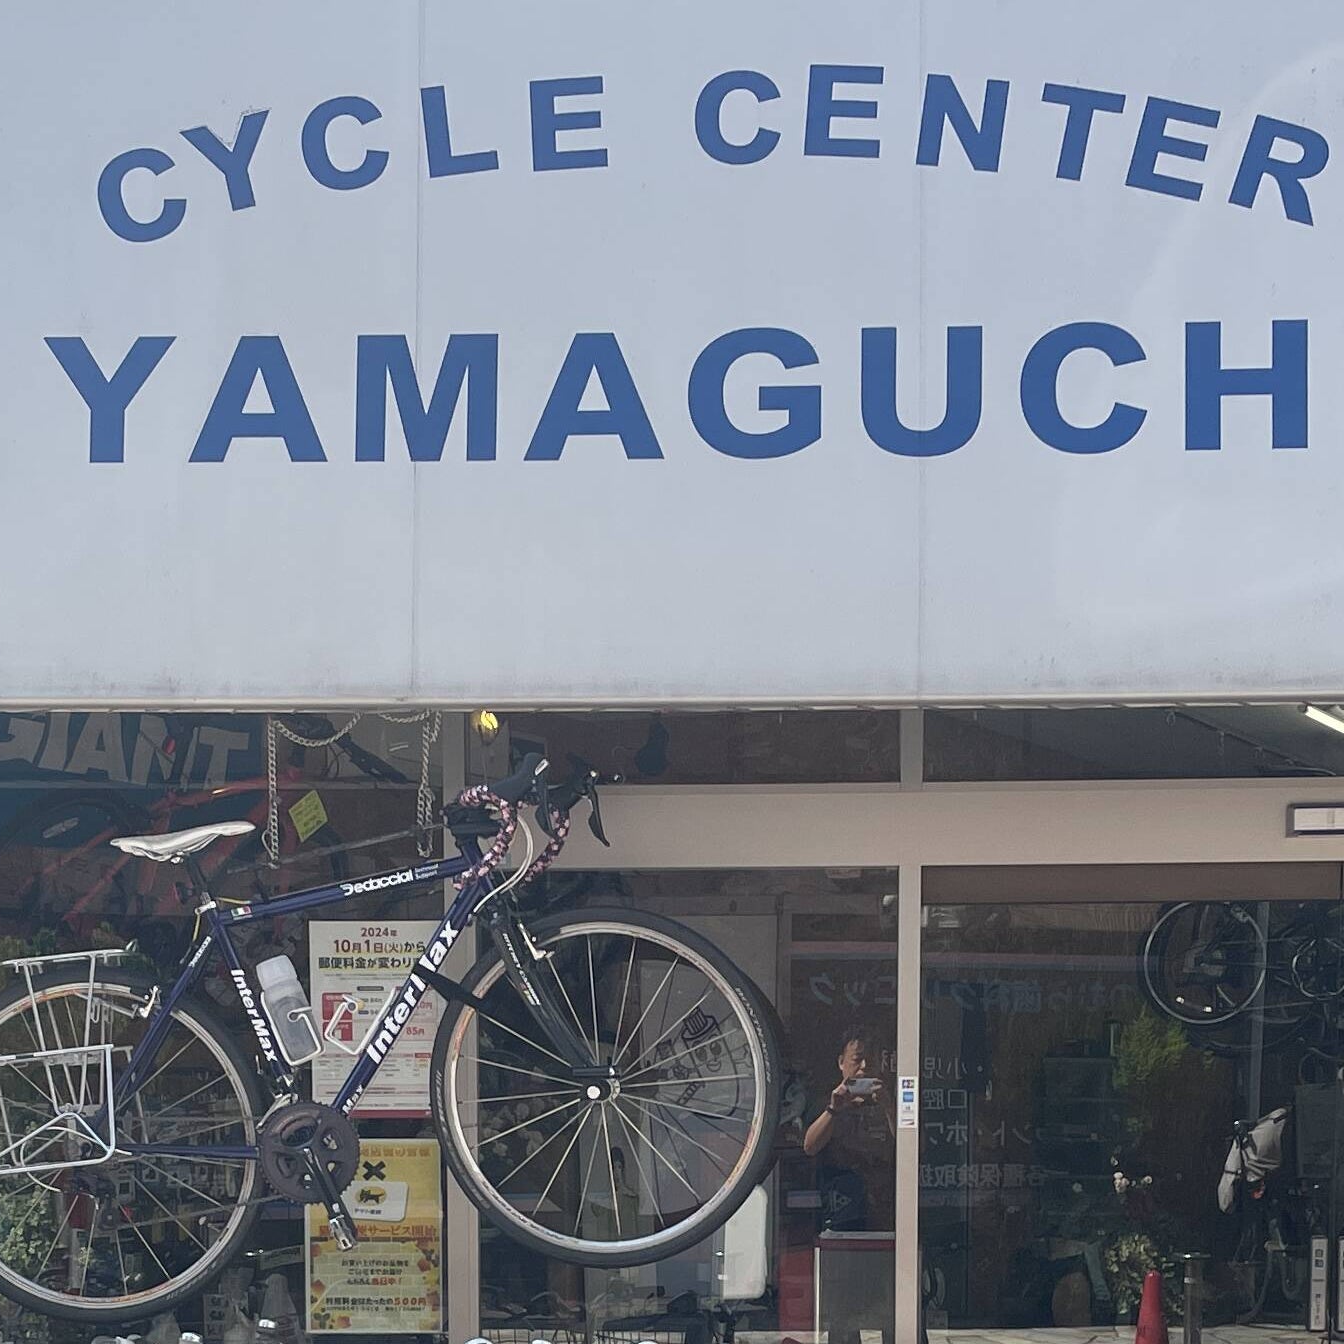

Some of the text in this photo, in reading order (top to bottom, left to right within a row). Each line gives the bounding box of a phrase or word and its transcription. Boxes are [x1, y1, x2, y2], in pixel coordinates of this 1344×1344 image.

[96, 63, 1330, 243] CYCLE CENTER
[333, 939, 427, 954] 10月1日(火)から
[230, 969, 278, 1062] InterMax
